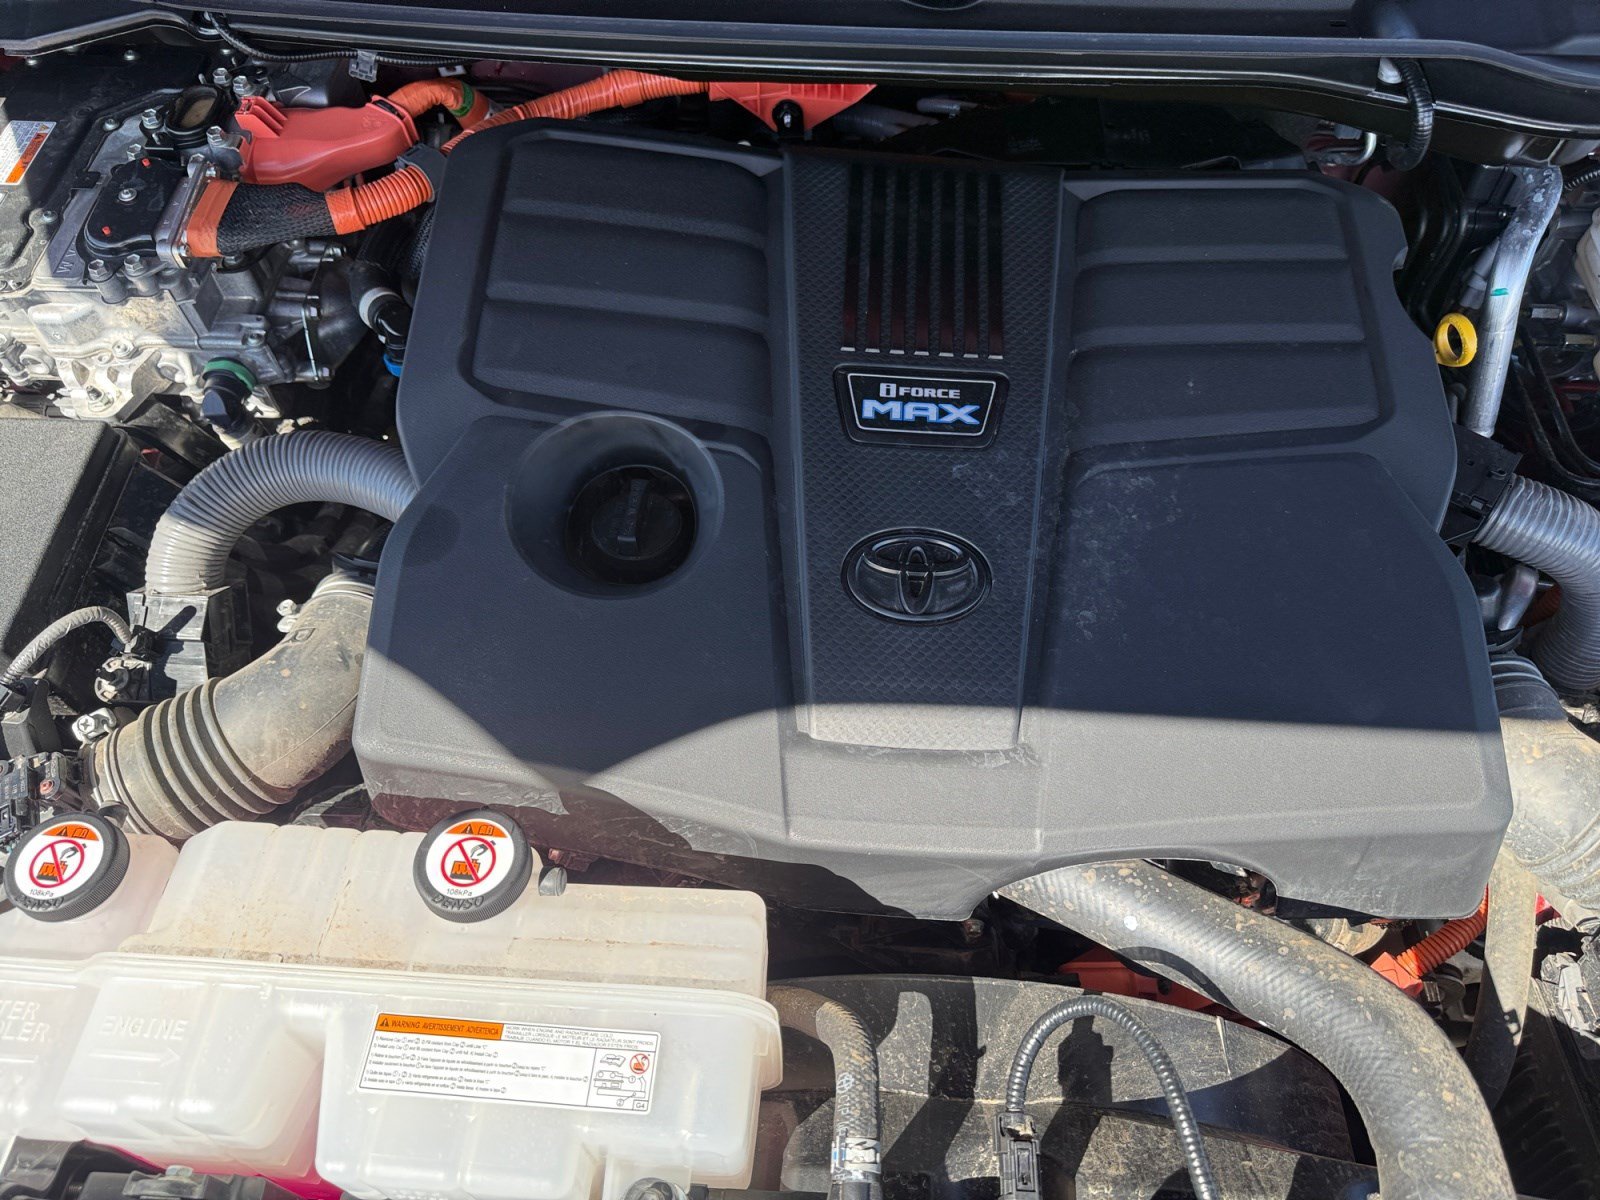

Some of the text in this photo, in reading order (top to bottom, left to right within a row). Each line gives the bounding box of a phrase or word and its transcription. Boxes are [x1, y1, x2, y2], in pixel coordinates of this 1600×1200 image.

[861, 399, 981, 425] MAX
[446, 888, 473, 897] 108kPa
[98, 1015, 190, 1041] ENGINE
[390, 1019, 421, 1029] WARNING
[421, 1021, 465, 1032] AVERTISSEMENT
[635, 1101, 645, 1109] G4
